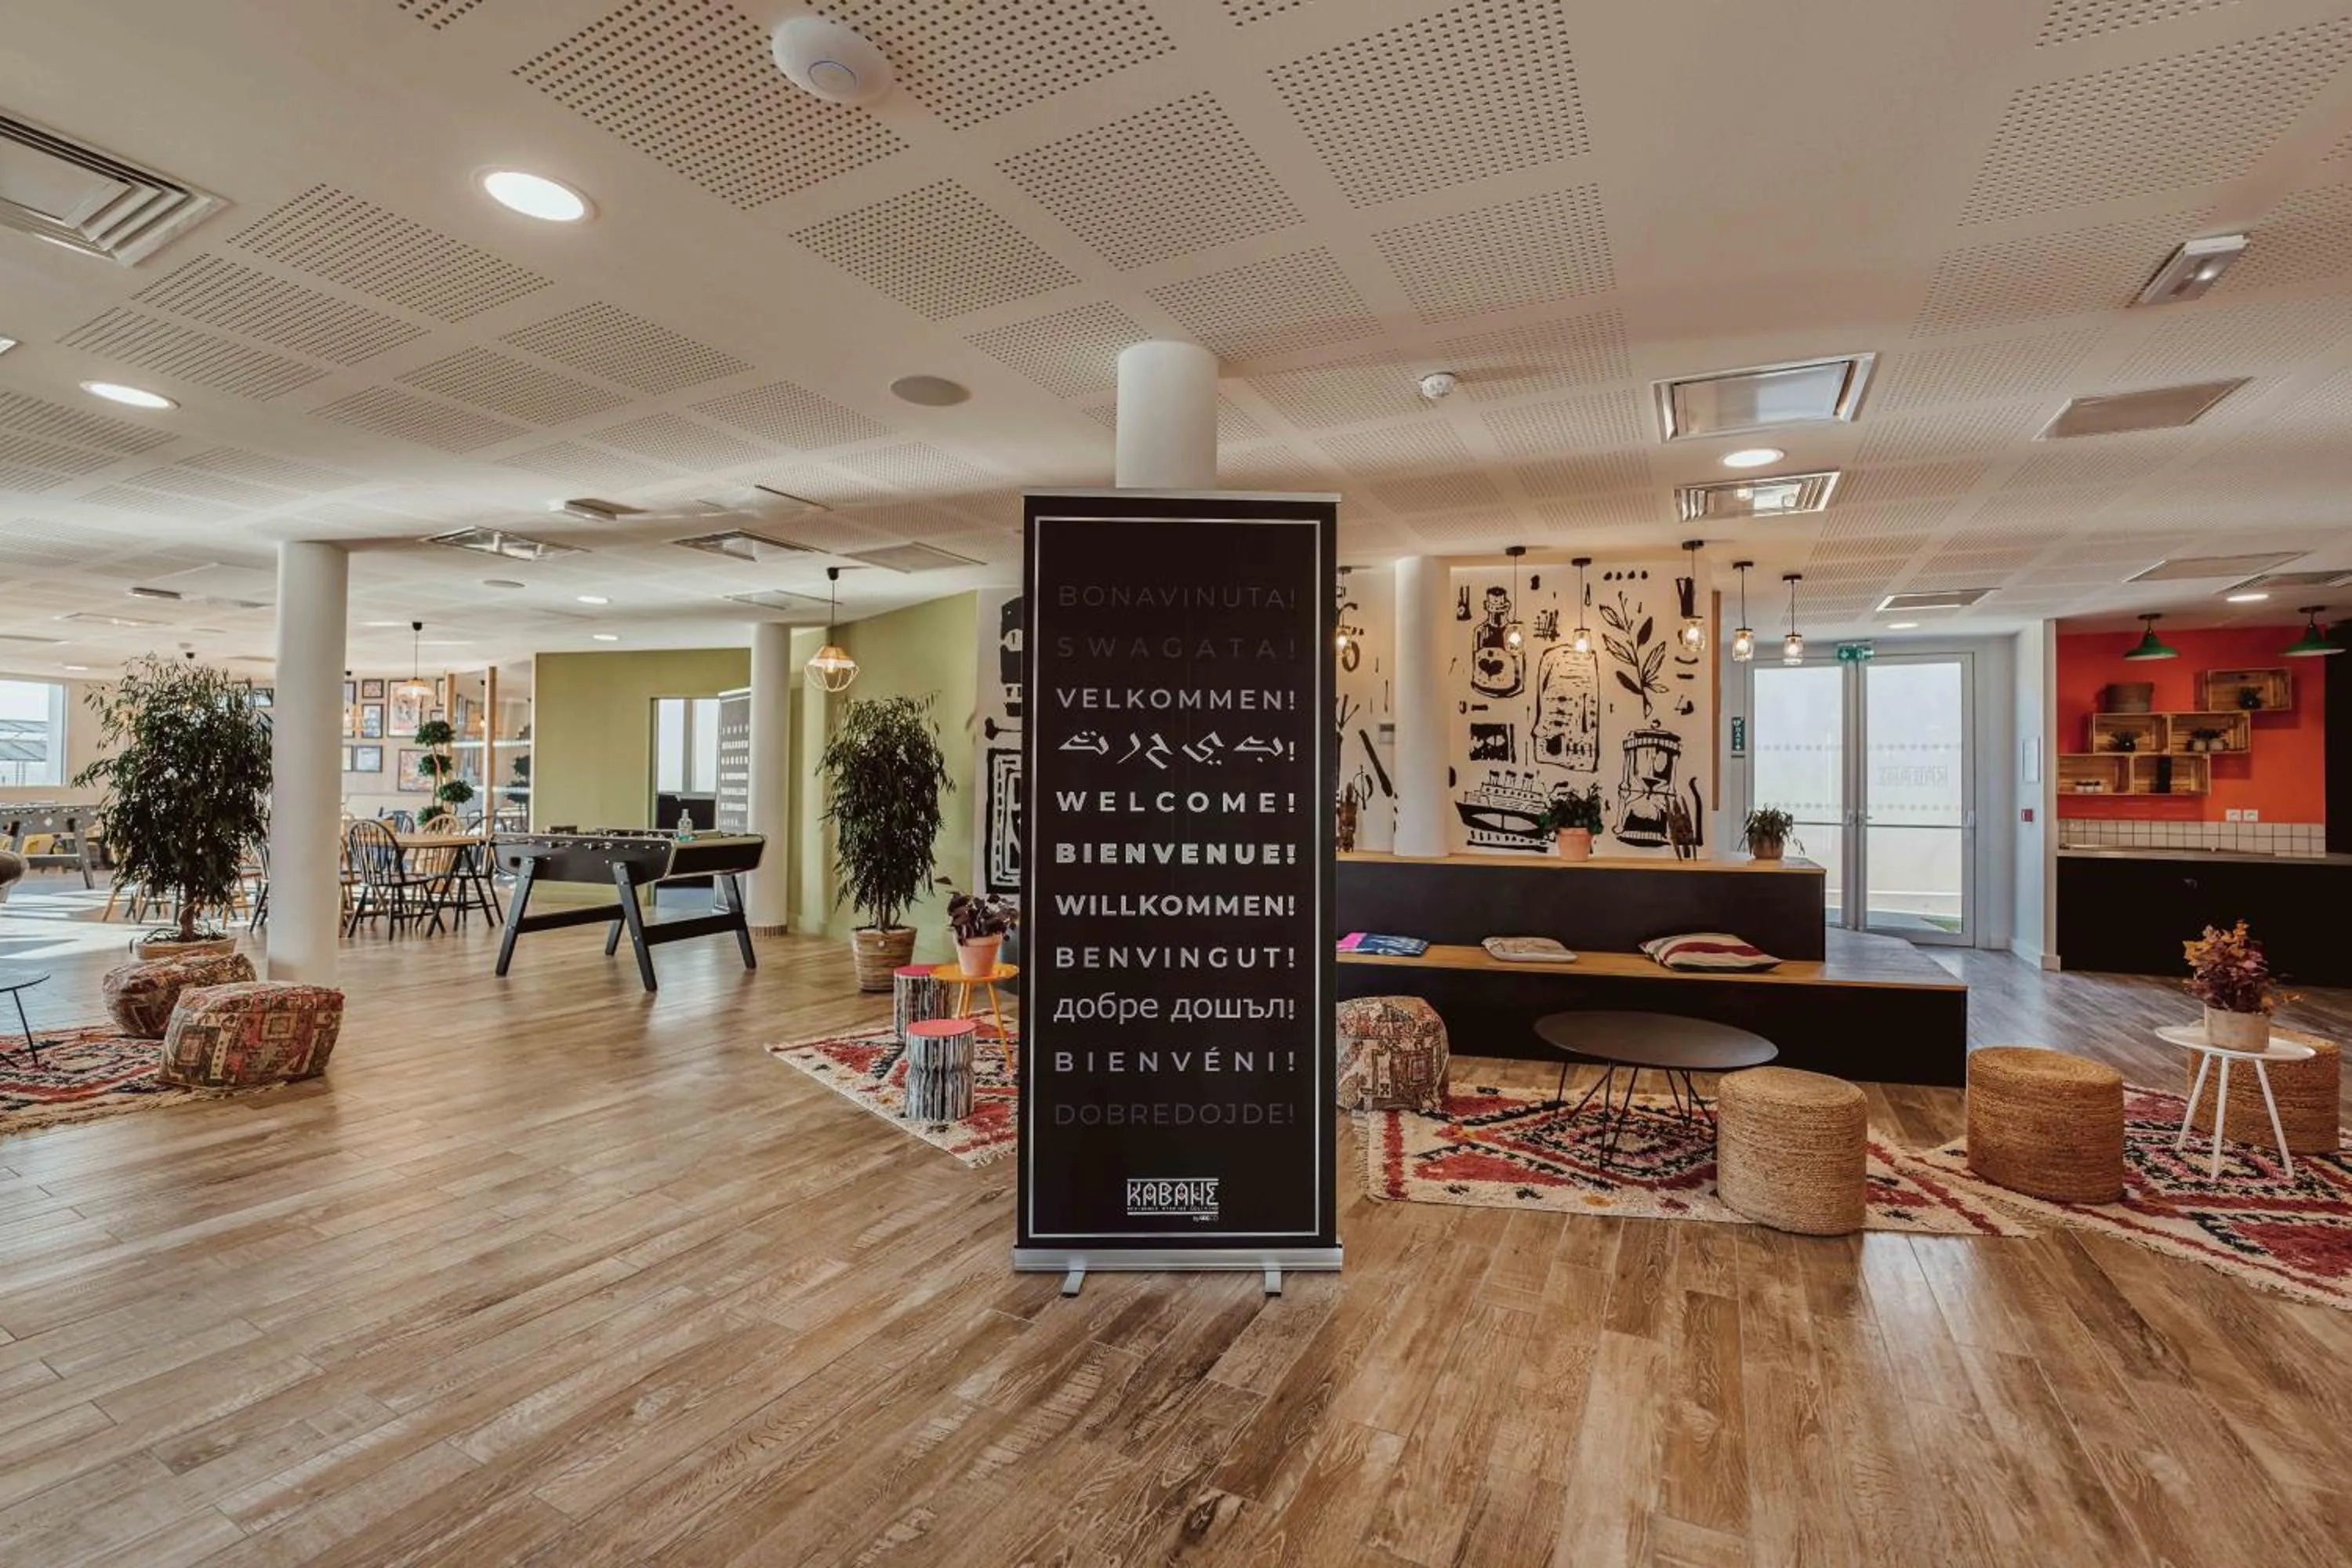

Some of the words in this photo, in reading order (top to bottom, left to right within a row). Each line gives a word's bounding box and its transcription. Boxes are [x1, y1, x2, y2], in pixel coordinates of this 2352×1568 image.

[1058, 585, 1295, 610] BONAVINUTA!
[1057, 637, 1295, 660] SWAGATA!
[1056, 688, 1295, 710] VELKOMMEN!
[1055, 791, 1295, 813] WELCOME!
[1055, 843, 1296, 865] BIENVENUE!
[1054, 895, 1295, 916] WILLKOMMEN!
[1055, 946, 1295, 968] BENVINGUT!
[1053, 991, 1159, 1024] добре
[1170, 998, 1294, 1023] дошъл!
[1054, 1046, 1295, 1073] BIENVÉNI!
[1054, 1102, 1294, 1125] DOBREDOJDE!
[1127, 1181, 1219, 1207] KABANE
